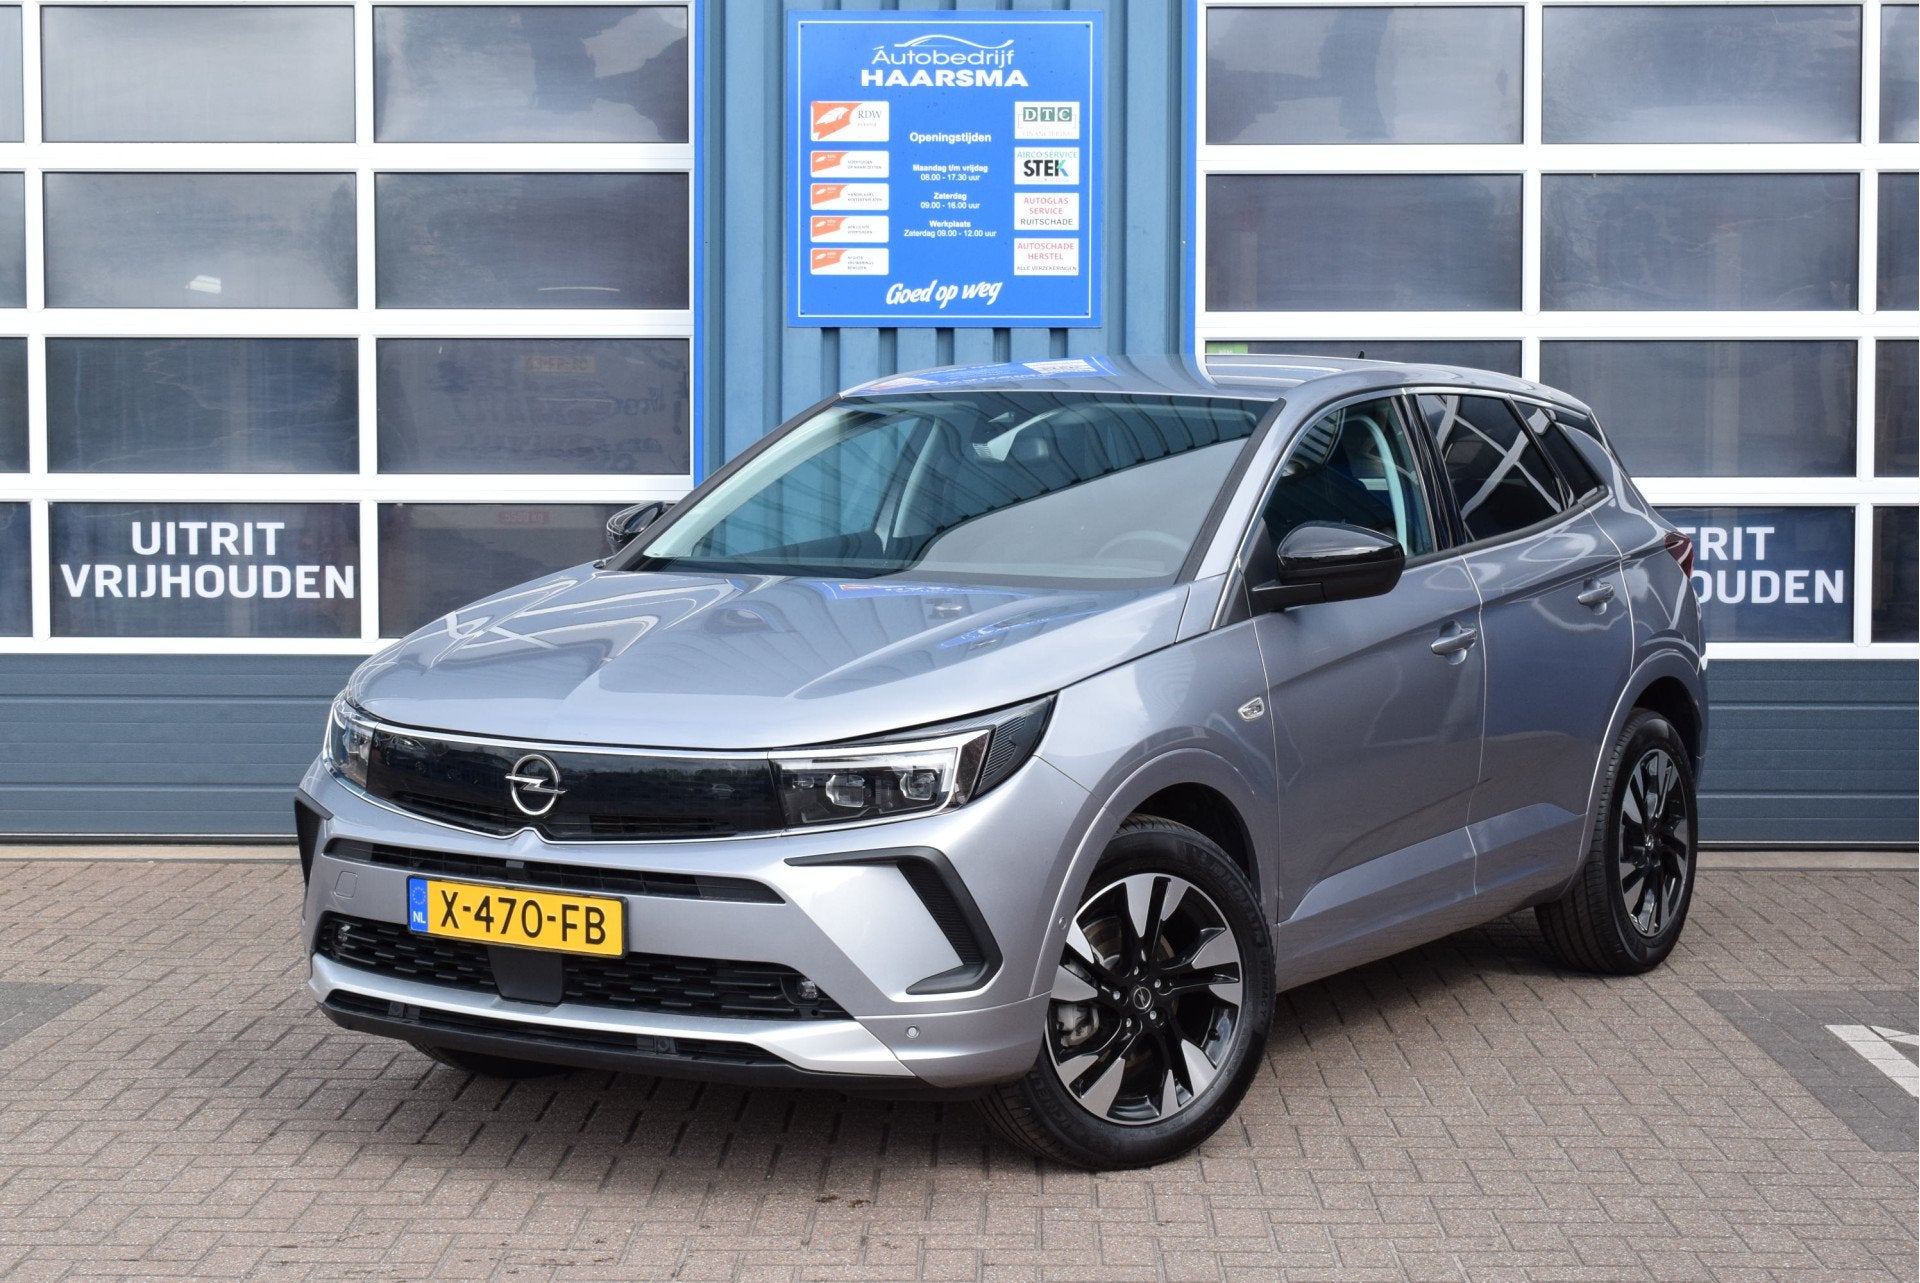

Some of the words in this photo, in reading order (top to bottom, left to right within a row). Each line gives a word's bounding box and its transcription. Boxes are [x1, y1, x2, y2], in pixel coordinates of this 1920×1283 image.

[872, 49, 1014, 68] Autobedrijf
[861, 69, 1029, 87] HAARSMA
[858, 110, 882, 119] RDW
[1023, 107, 1072, 121] DTC
[909, 132, 992, 144] Openingstijden
[1017, 151, 1043, 159] AIRCO
[1044, 151, 1078, 159] SERVICE
[912, 164, 947, 173] Maandag
[948, 164, 961, 172] t/m
[962, 164, 988, 173] vrijdag
[1023, 159, 1069, 177] STEK
[920, 173, 941, 181] 08.00
[947, 173, 967, 181] 17.30
[933, 192, 967, 201] Zaterdag
[1023, 197, 1069, 205] AUTOGLAS
[920, 201, 941, 209] 09.00
[947, 201, 967, 209] 16.00
[1029, 207, 1063, 215] SERVICE
[929, 220, 972, 229] Werkplaats
[1020, 218, 1073, 226] RUITSCHADE
[903, 229, 936, 238] Zaterdag
[936, 229, 957, 237] 09.00
[963, 229, 984, 237] 12.00
[1017, 242, 1074, 250] AUTOSCHADE
[1027, 252, 1064, 260] HERSTEL
[885, 279, 938, 305] Goed
[935, 284, 958, 309] op
[961, 281, 1003, 306] weg
[131, 521, 285, 556] UITRIT
[1677, 526, 1775, 561] RIT
[60, 563, 355, 599] VRIJHOUDEN
[1689, 569, 1844, 604] OUDEN
[413, 910, 426, 924] NL
[440, 889, 606, 945] X-470-FB
